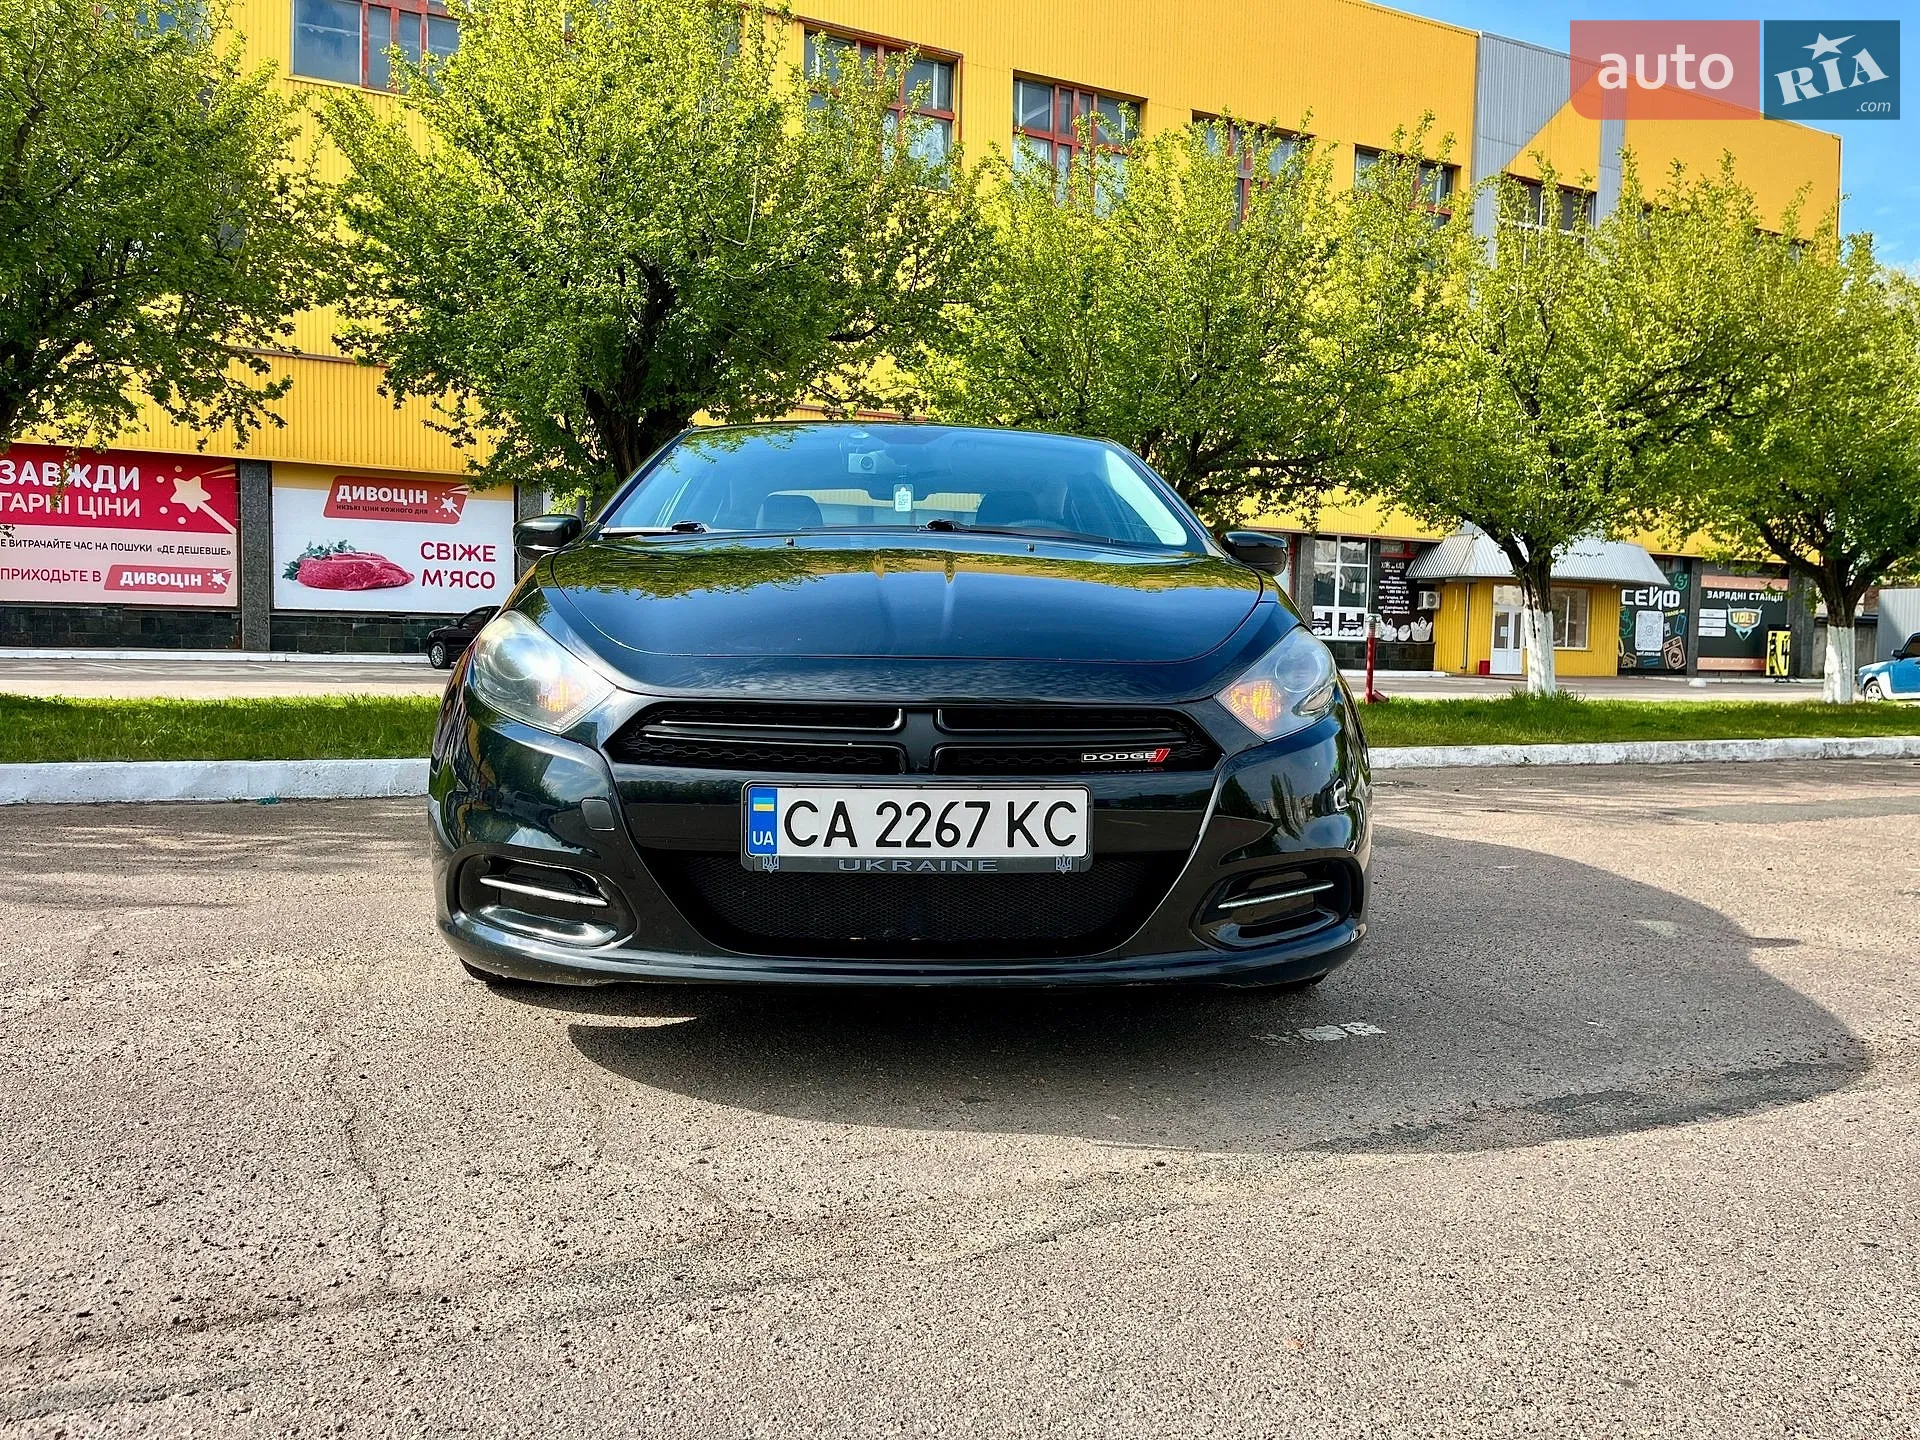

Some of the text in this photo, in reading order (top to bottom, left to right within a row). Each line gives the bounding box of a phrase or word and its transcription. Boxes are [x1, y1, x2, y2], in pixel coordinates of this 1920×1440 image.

[0, 460, 140, 493] ЗАВЖДИ
[336, 485, 429, 506] ДИВОЦІН
[77, 495, 140, 519] ЦІНИ
[362, 505, 379, 513] ЦІНИ
[380, 506, 413, 514] КОЖНОГО
[9, 539, 71, 549] ВИТРАЧАЙТЕ
[74, 541, 93, 550] ЧАС
[95, 543, 108, 551] НА
[110, 543, 153, 552] ПОШУКИ
[157, 545, 175, 554] «ДЕ
[177, 546, 232, 555] ДЕШЕВШЕ»
[420, 542, 496, 562] СВІЖЕ
[0, 568, 101, 583] ПРИХОДЬТЕ В
[120, 571, 202, 588] ДИВОЦІН
[421, 569, 496, 589] М’ЯСО
[1621, 586, 1680, 610] СЕЙФ
[1707, 590, 1747, 601] ЗАРЯДНІ
[1732, 611, 1757, 624] VOLT
[1083, 752, 1157, 761] DODGE
[784, 800, 1077, 848] CA 2267 KC
[752, 831, 774, 846] UA
[838, 859, 998, 872] UKRAINE
